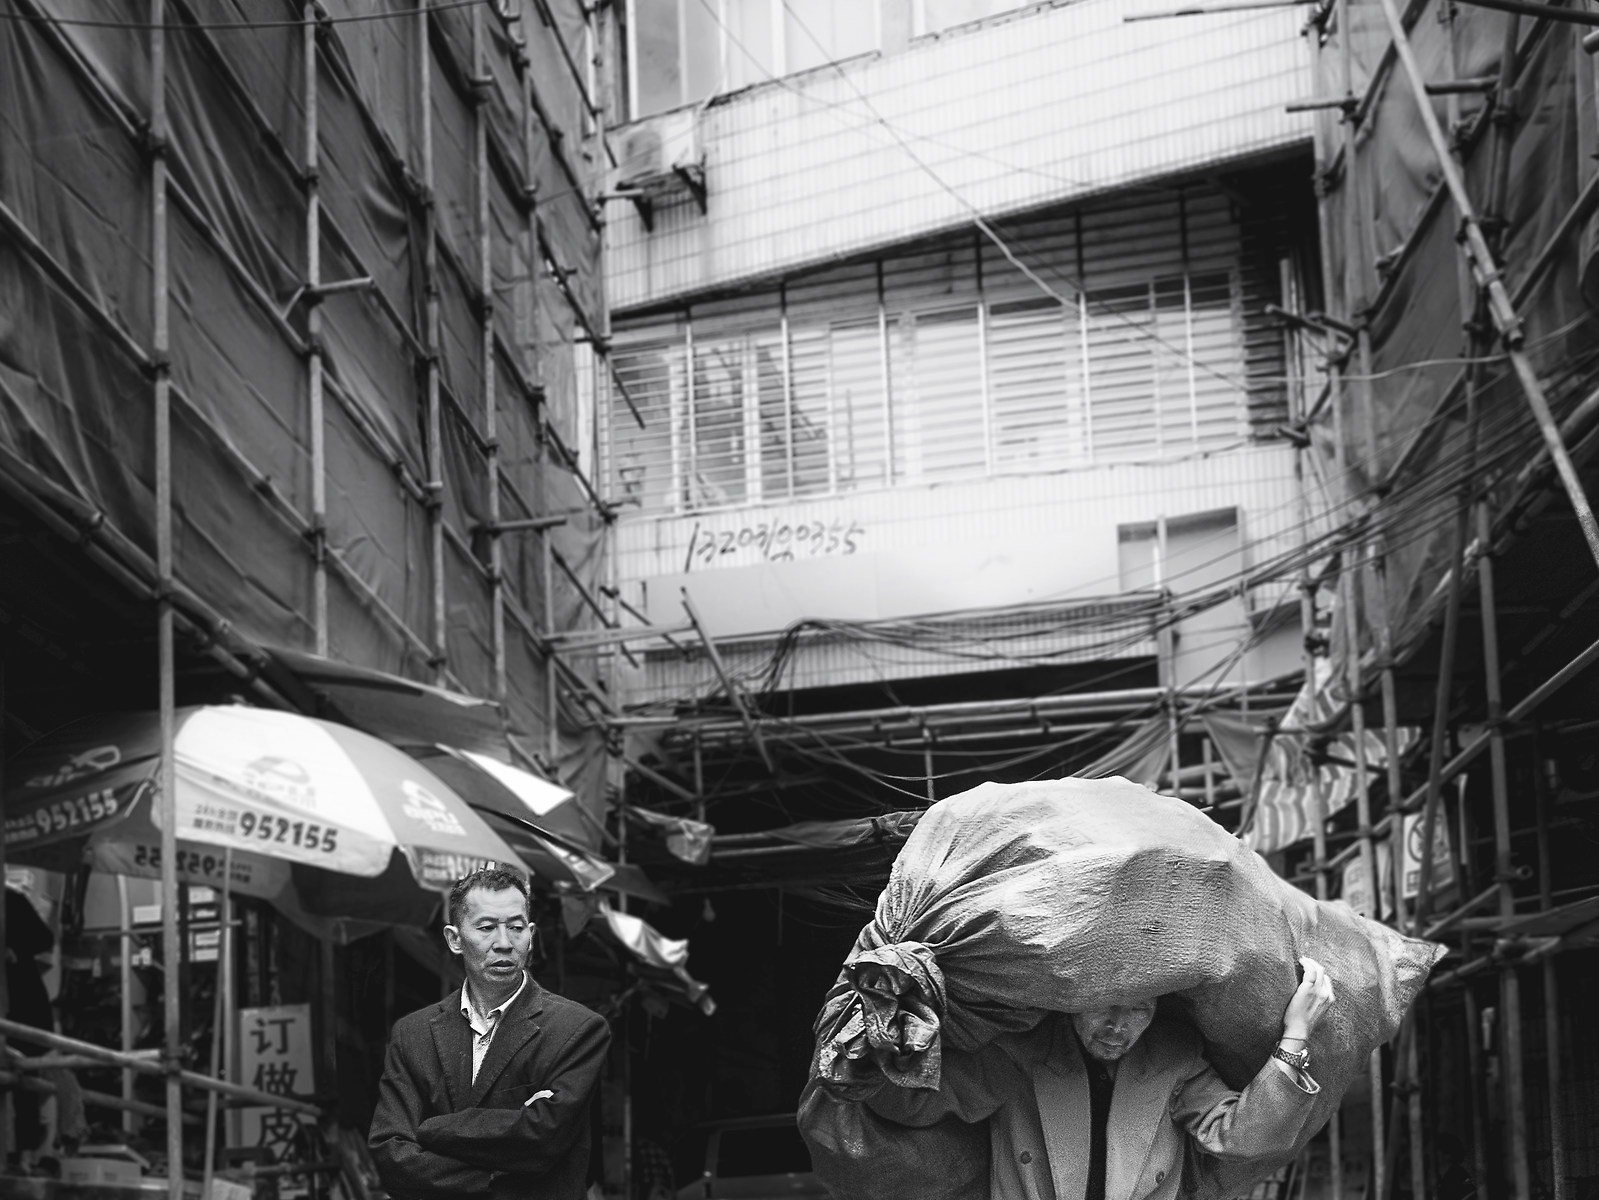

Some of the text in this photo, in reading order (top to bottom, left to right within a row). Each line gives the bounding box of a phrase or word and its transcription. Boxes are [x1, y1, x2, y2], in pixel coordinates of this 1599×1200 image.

[36, 788, 118, 834] 952155
[240, 811, 338, 853] 952155
[250, 1017, 301, 1194] 订做皮
